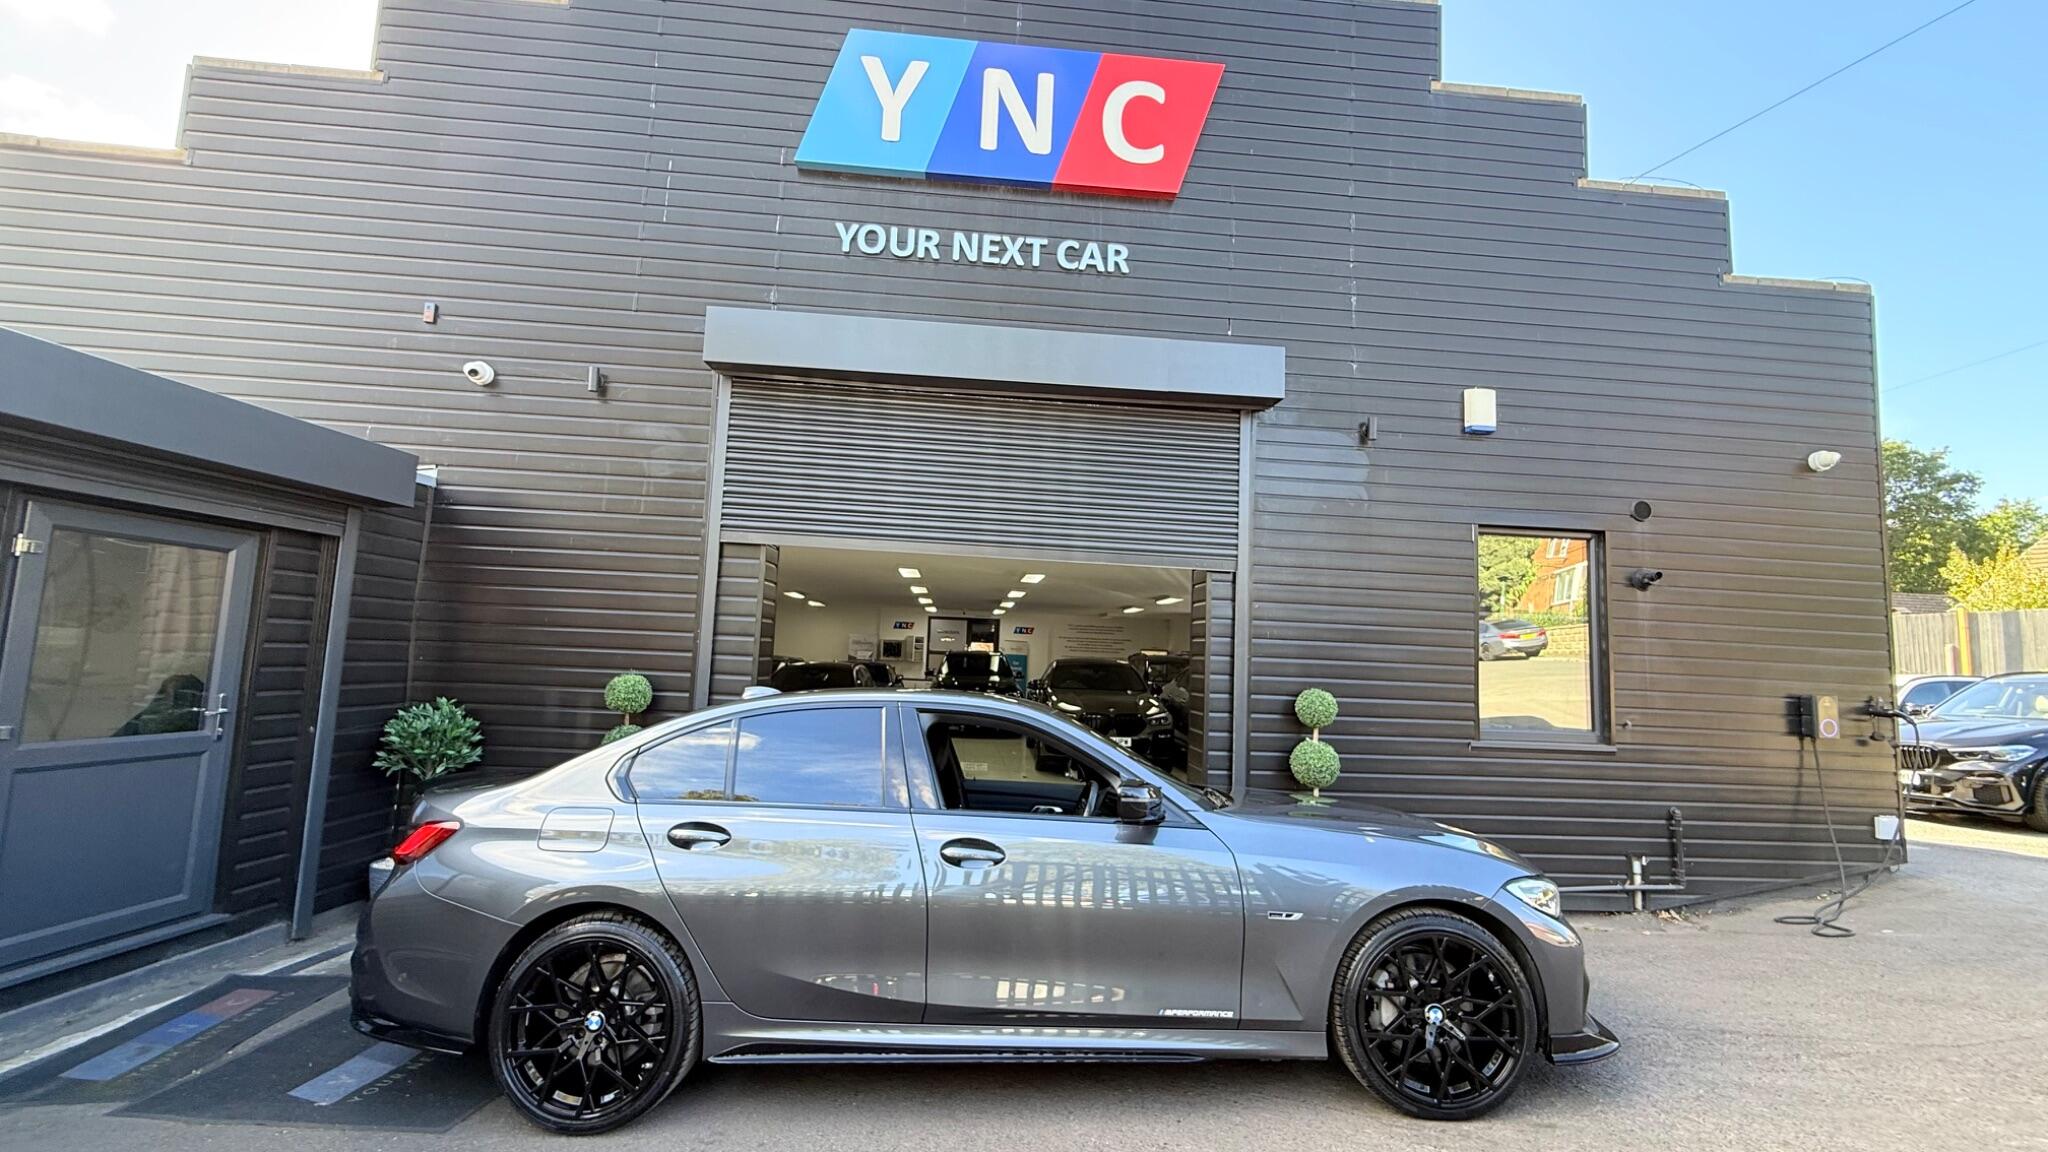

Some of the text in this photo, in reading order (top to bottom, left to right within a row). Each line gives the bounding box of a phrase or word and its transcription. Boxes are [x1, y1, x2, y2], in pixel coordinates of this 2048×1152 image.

[859, 54, 1167, 165] YNC
[834, 221, 1130, 274] YOUR NEXT CAR
